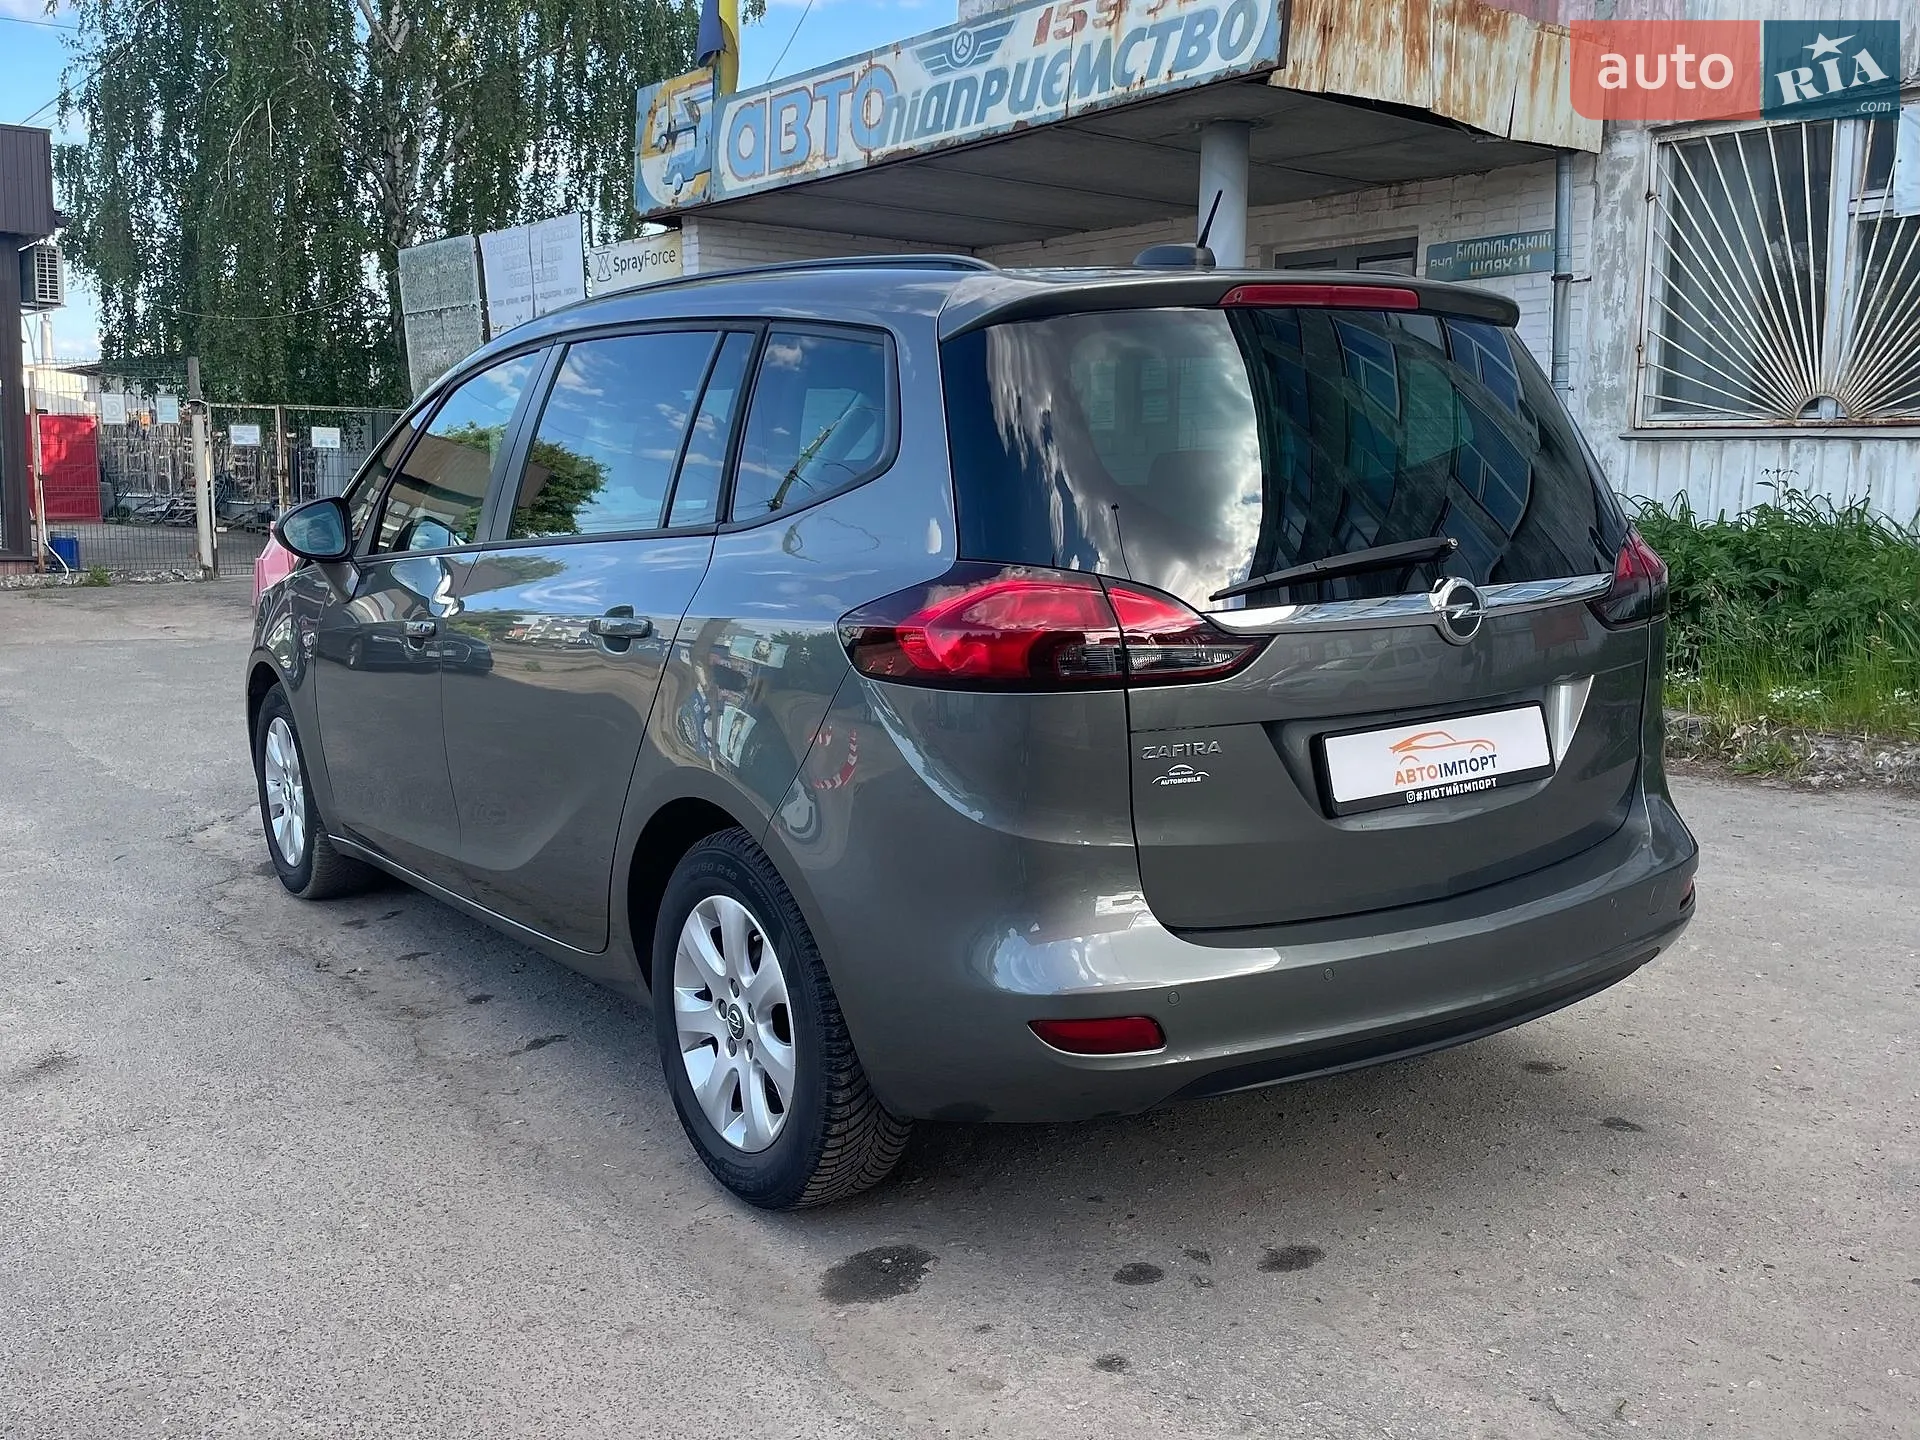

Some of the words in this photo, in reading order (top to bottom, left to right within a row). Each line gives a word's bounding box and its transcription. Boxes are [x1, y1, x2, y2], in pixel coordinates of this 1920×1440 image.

[613, 249, 676, 276] SprayForce
[1141, 740, 1223, 760] ZAFIRA
[1160, 776, 1202, 786] AUTOMOBILE
[1394, 754, 1497, 786] АВТОІМПОРТ
